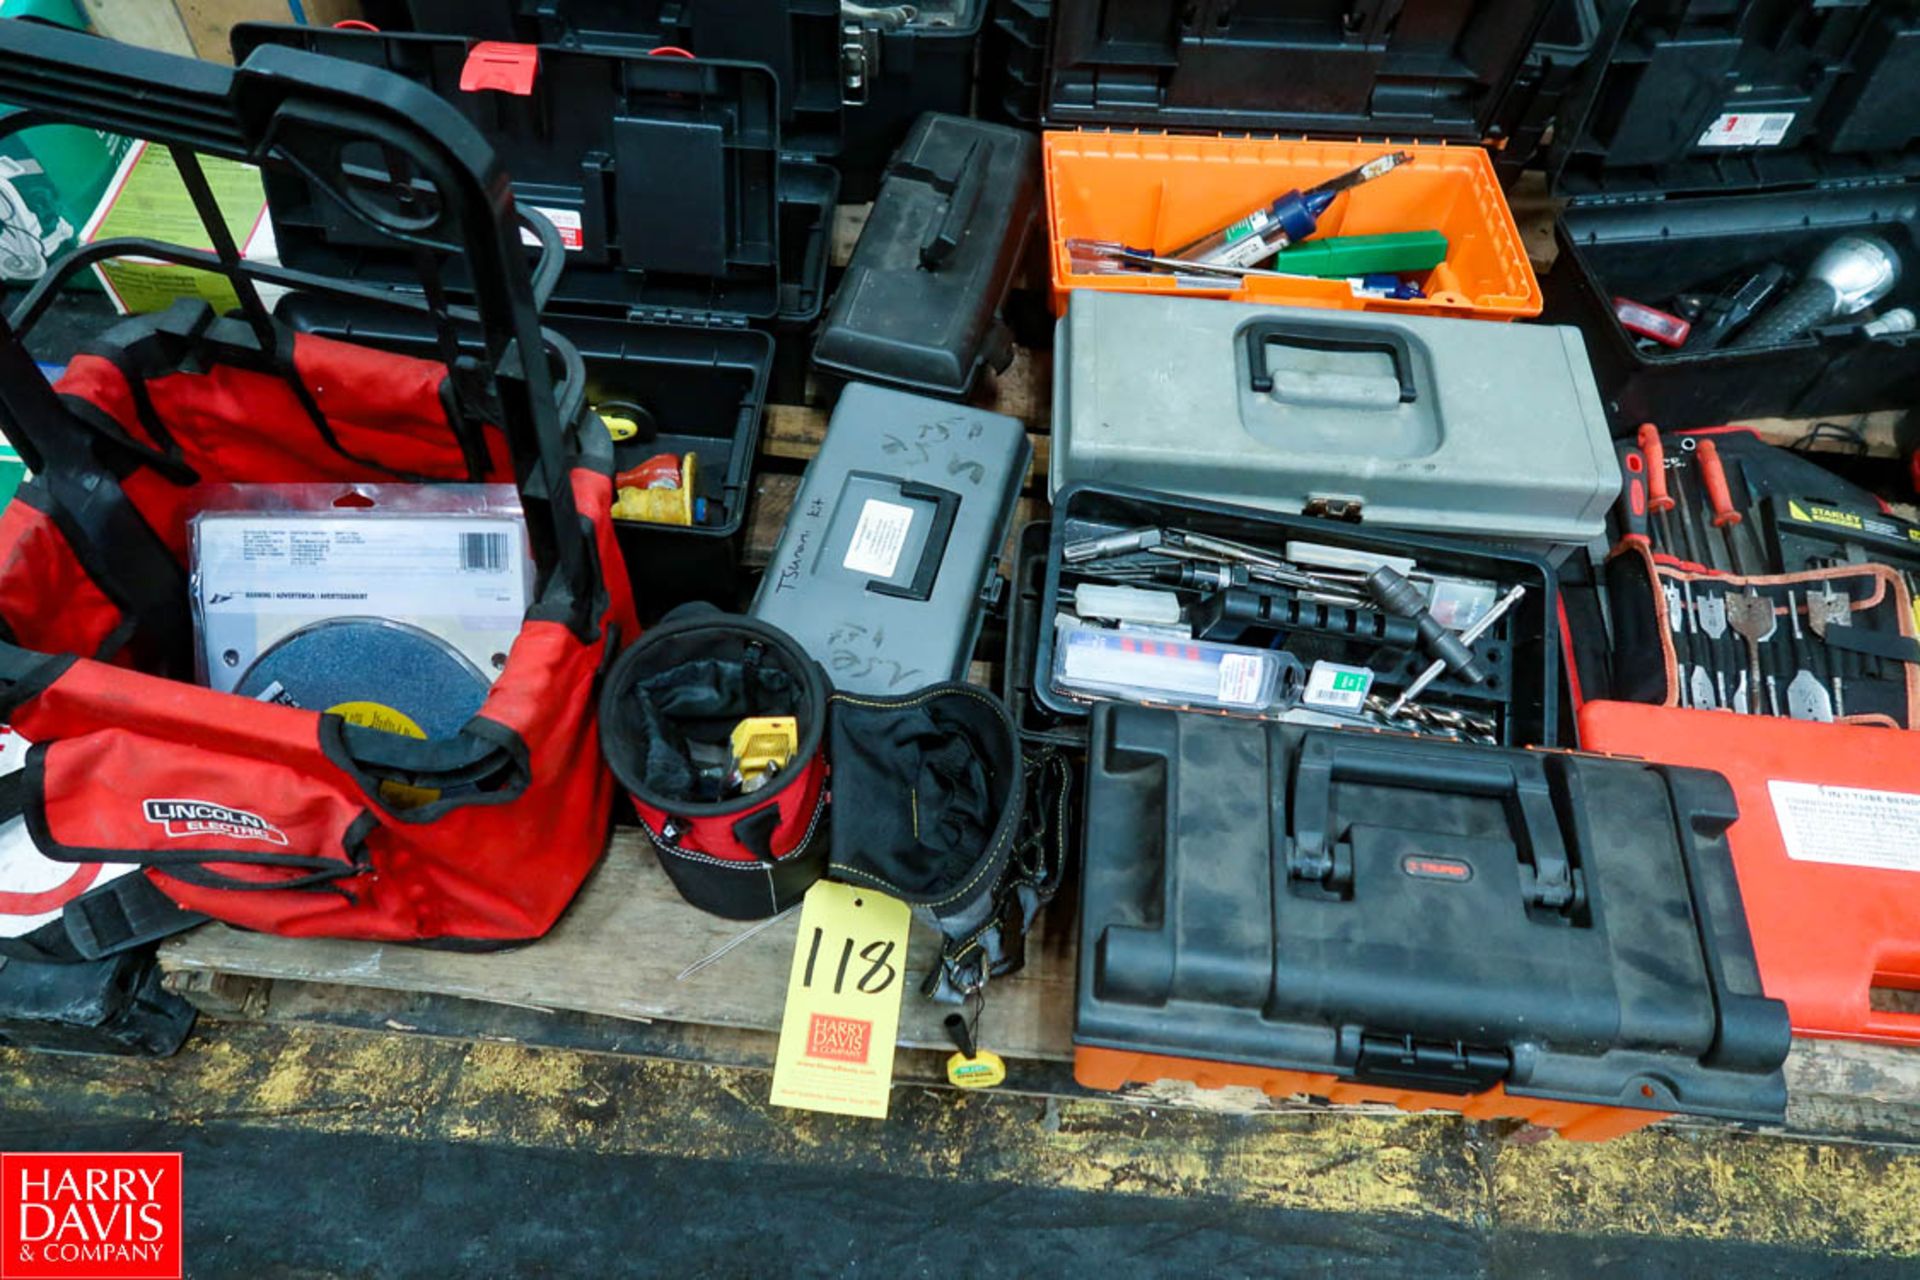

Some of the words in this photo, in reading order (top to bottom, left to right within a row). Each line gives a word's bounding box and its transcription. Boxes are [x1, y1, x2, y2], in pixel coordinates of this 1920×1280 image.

[153, 804, 267, 829] LINCOLN
[187, 820, 268, 838] ELECTRIC
[803, 926, 896, 995] 118
[815, 1018, 867, 1035] HARRY
[813, 1031, 863, 1051] DAVIS
